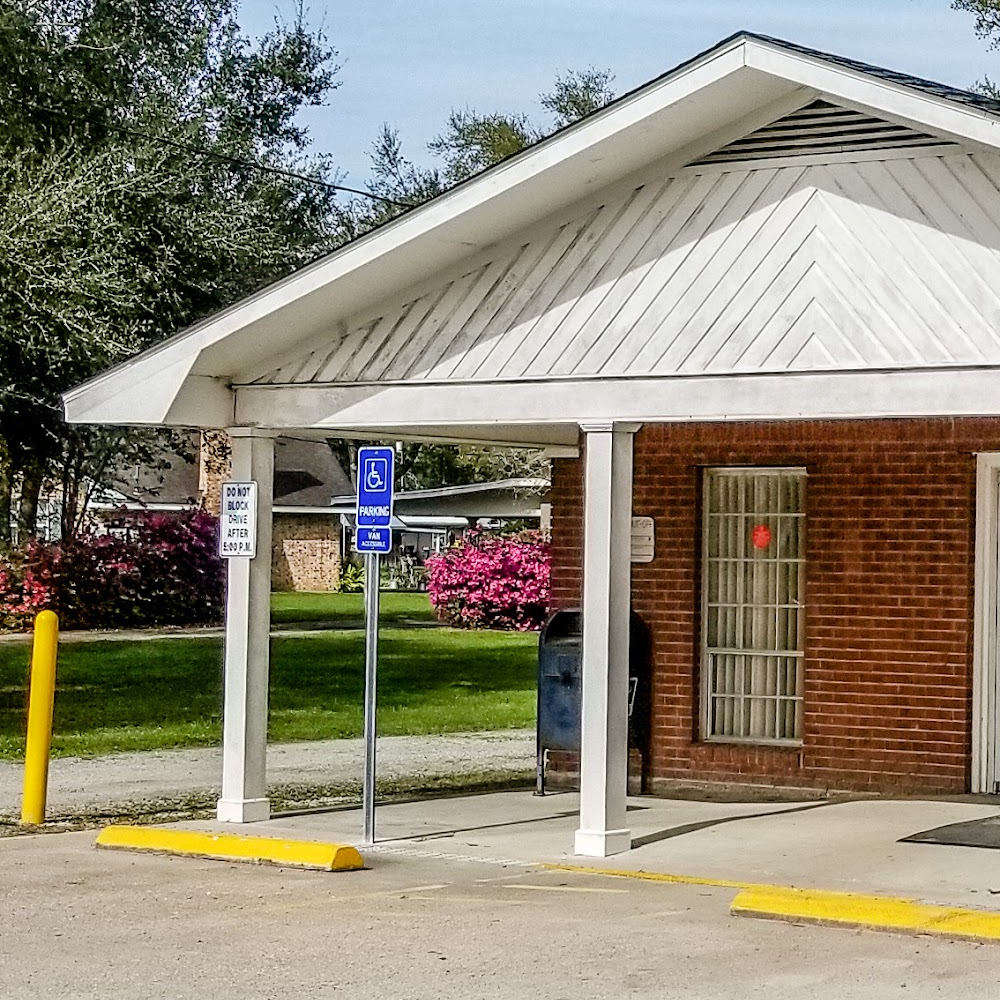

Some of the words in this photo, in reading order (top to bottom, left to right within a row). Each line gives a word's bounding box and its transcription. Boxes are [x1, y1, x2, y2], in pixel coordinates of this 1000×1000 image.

[227, 487, 236, 497] DO
[238, 487, 250, 497] NOT
[228, 501, 249, 511] BLOCK
[359, 505, 390, 517] PARKING
[229, 514, 248, 524] DRIVE
[227, 528, 249, 538] AFTER
[367, 531, 381, 541] VAN
[223, 541, 238, 552] 5:00
